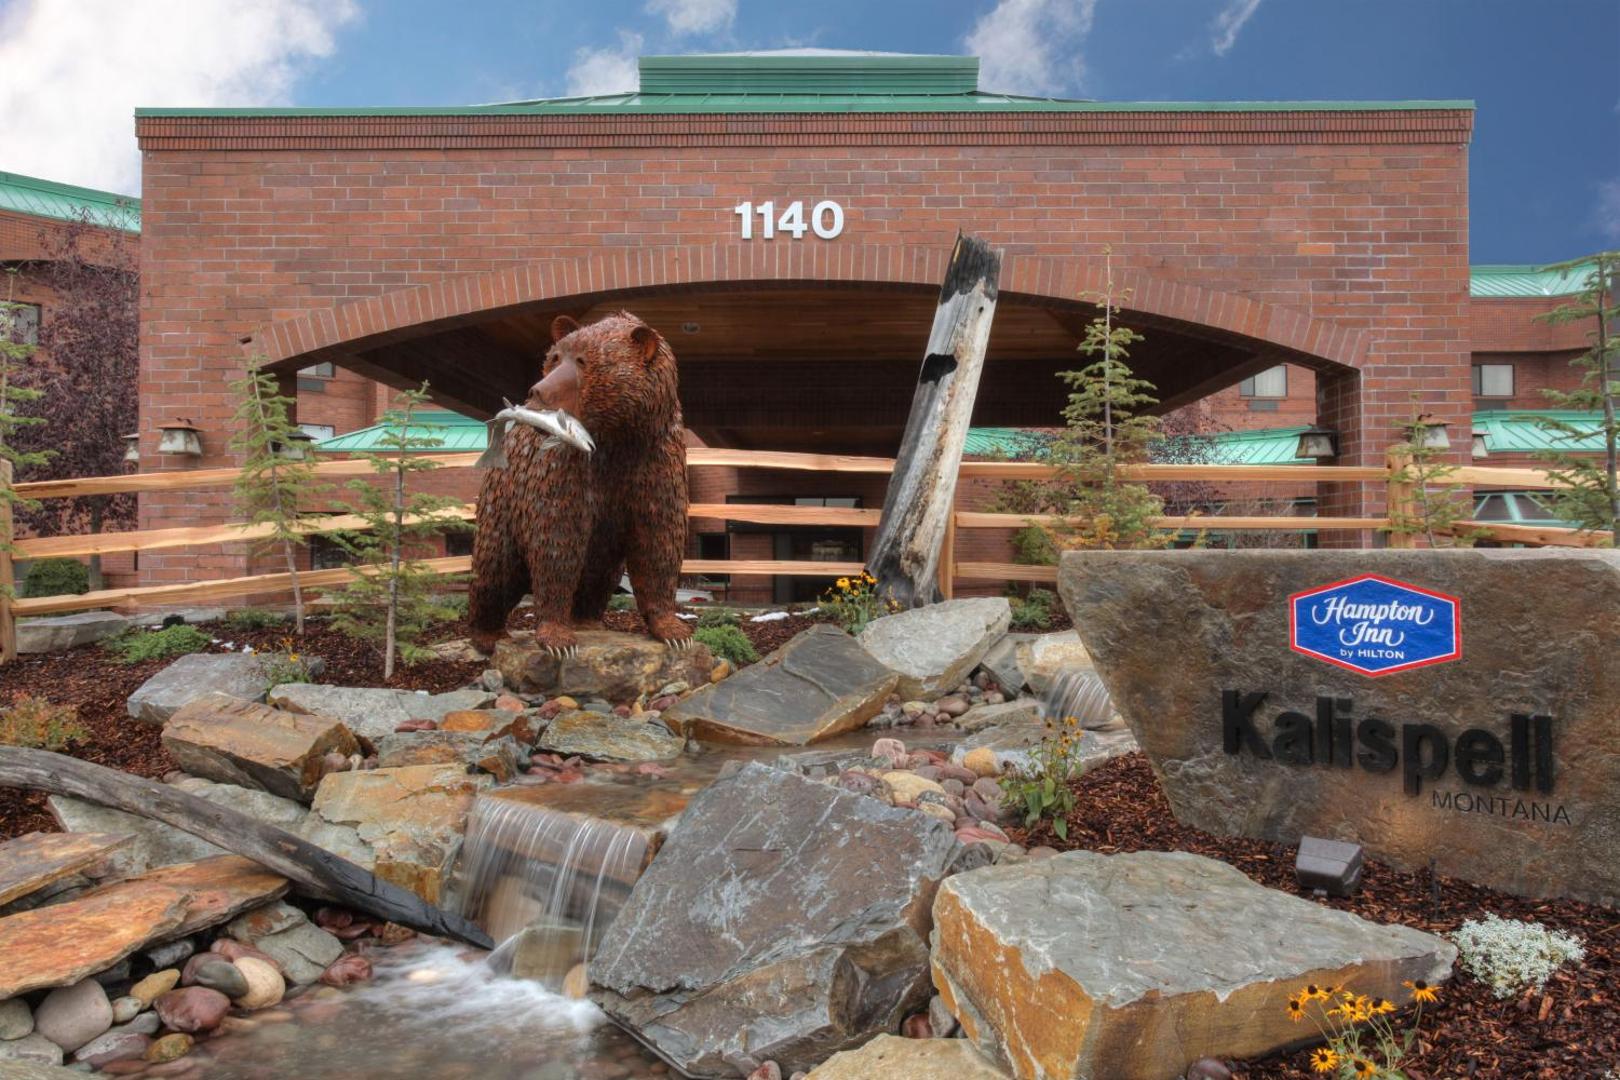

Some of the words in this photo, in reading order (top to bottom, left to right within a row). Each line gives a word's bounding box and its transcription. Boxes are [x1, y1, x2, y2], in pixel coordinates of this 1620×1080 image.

[735, 200, 844, 240] 1140
[1312, 596, 1434, 625] Hampton
[1339, 621, 1404, 647] Inn
[1340, 648, 1353, 658] by
[1358, 649, 1405, 659] HILTON
[1222, 690, 1554, 797] Kalispell
[1432, 790, 1571, 826] MONTANA
